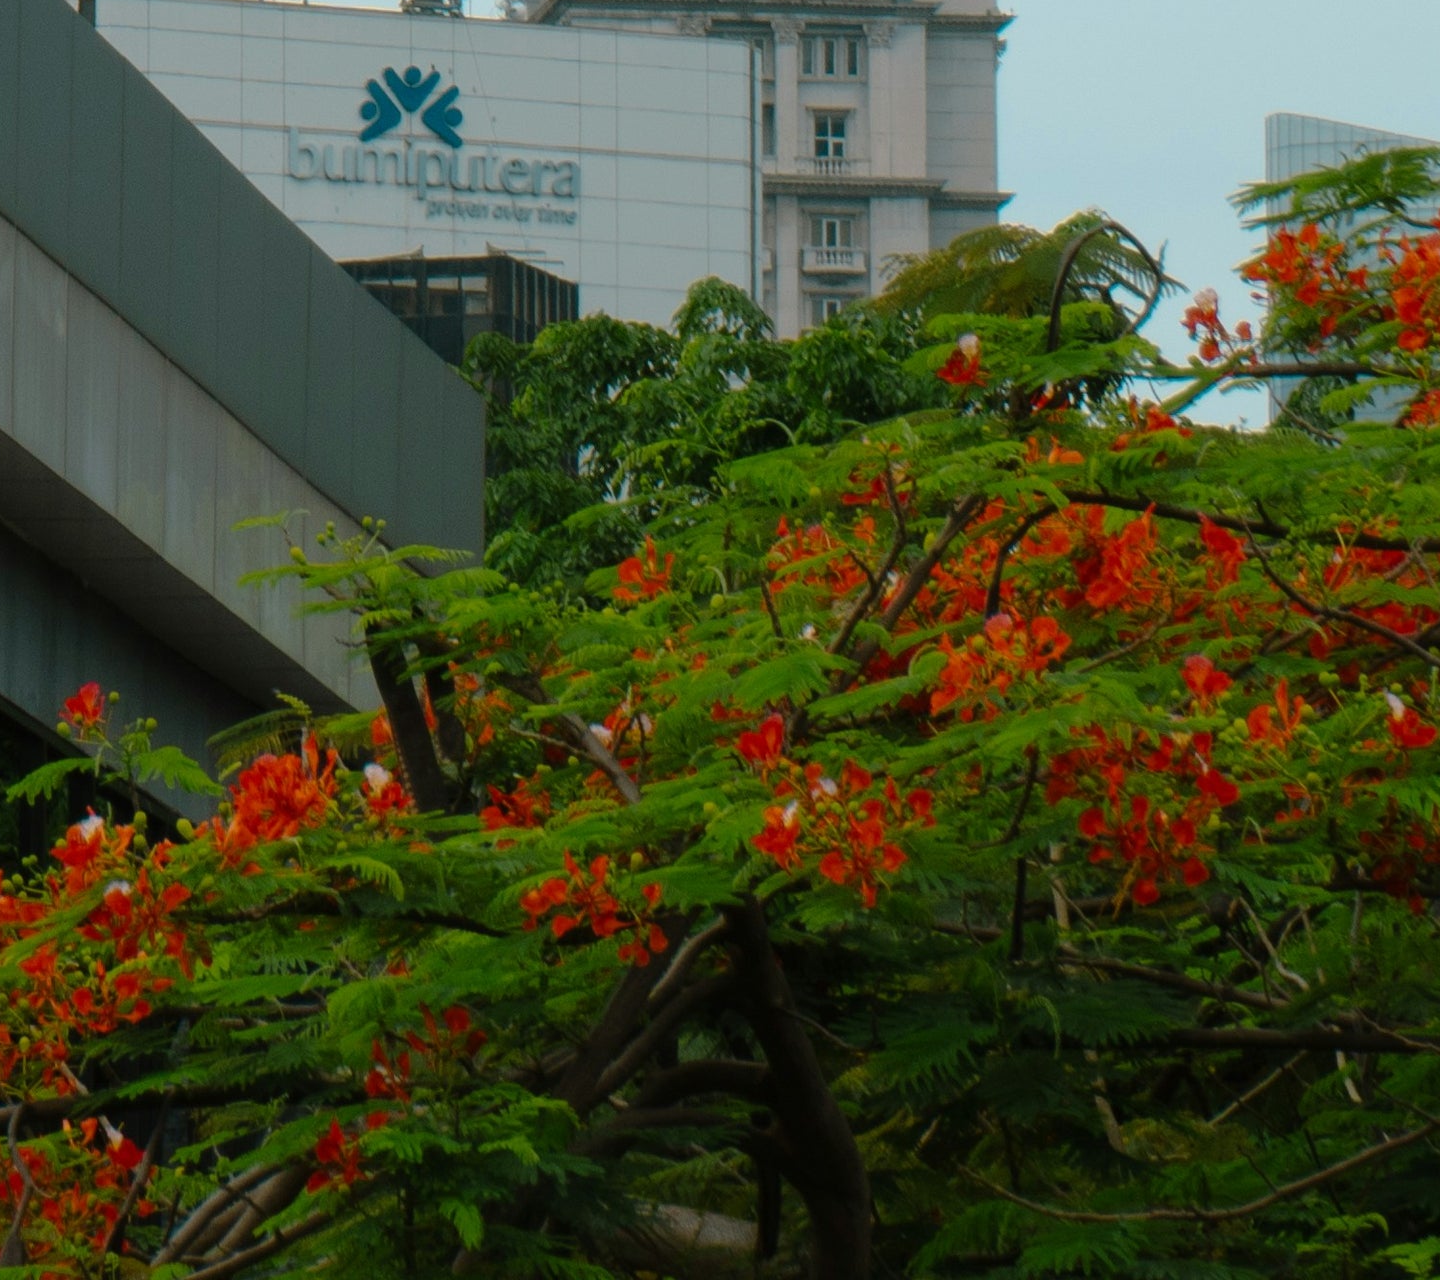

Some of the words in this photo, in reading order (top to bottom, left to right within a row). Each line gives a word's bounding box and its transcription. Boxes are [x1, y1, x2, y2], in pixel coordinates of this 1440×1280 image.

[287, 126, 581, 201] bumiputera
[425, 199, 490, 221] proven
[492, 204, 532, 223] over
[537, 203, 578, 226] time
